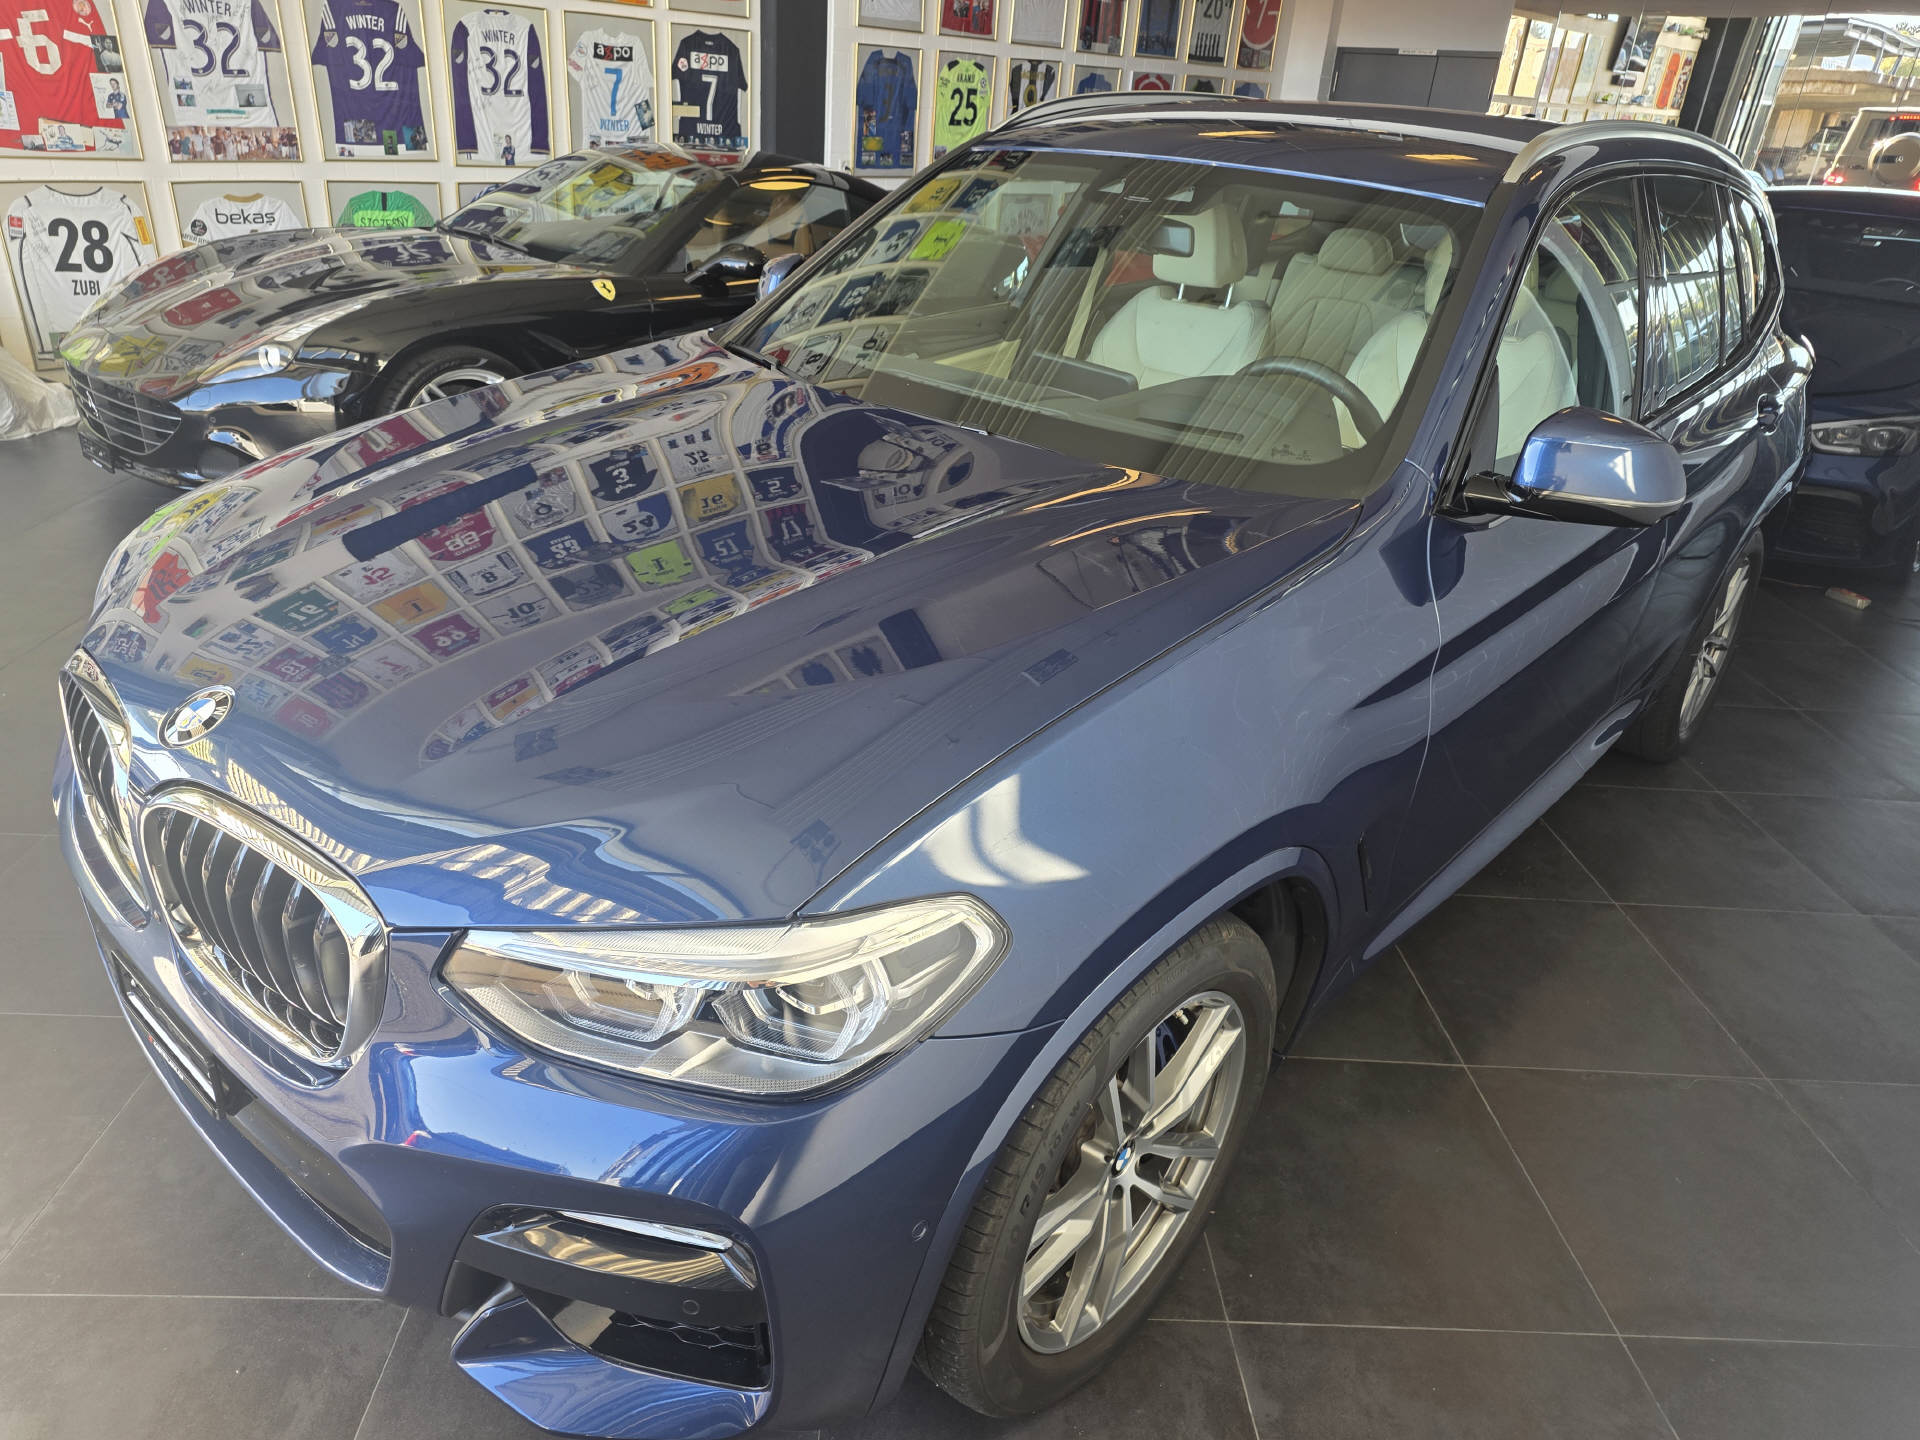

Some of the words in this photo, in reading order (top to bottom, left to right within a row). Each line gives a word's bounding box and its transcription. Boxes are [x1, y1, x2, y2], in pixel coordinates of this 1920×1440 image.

[183, 0, 232, 17] WINTER
[346, 14, 384, 32] WINTER
[16, 9, 62, 75] 6
[182, 19, 250, 77] 32
[482, 29, 515, 45] WINTER
[345, 36, 399, 91] 32
[480, 46, 525, 97] 32
[604, 67, 623, 116] 7
[701, 74, 718, 121] 7
[948, 87, 978, 127] 25
[600, 118, 630, 132] WINTER
[696, 122, 722, 136] WINTER
[47, 217, 114, 273] 28
